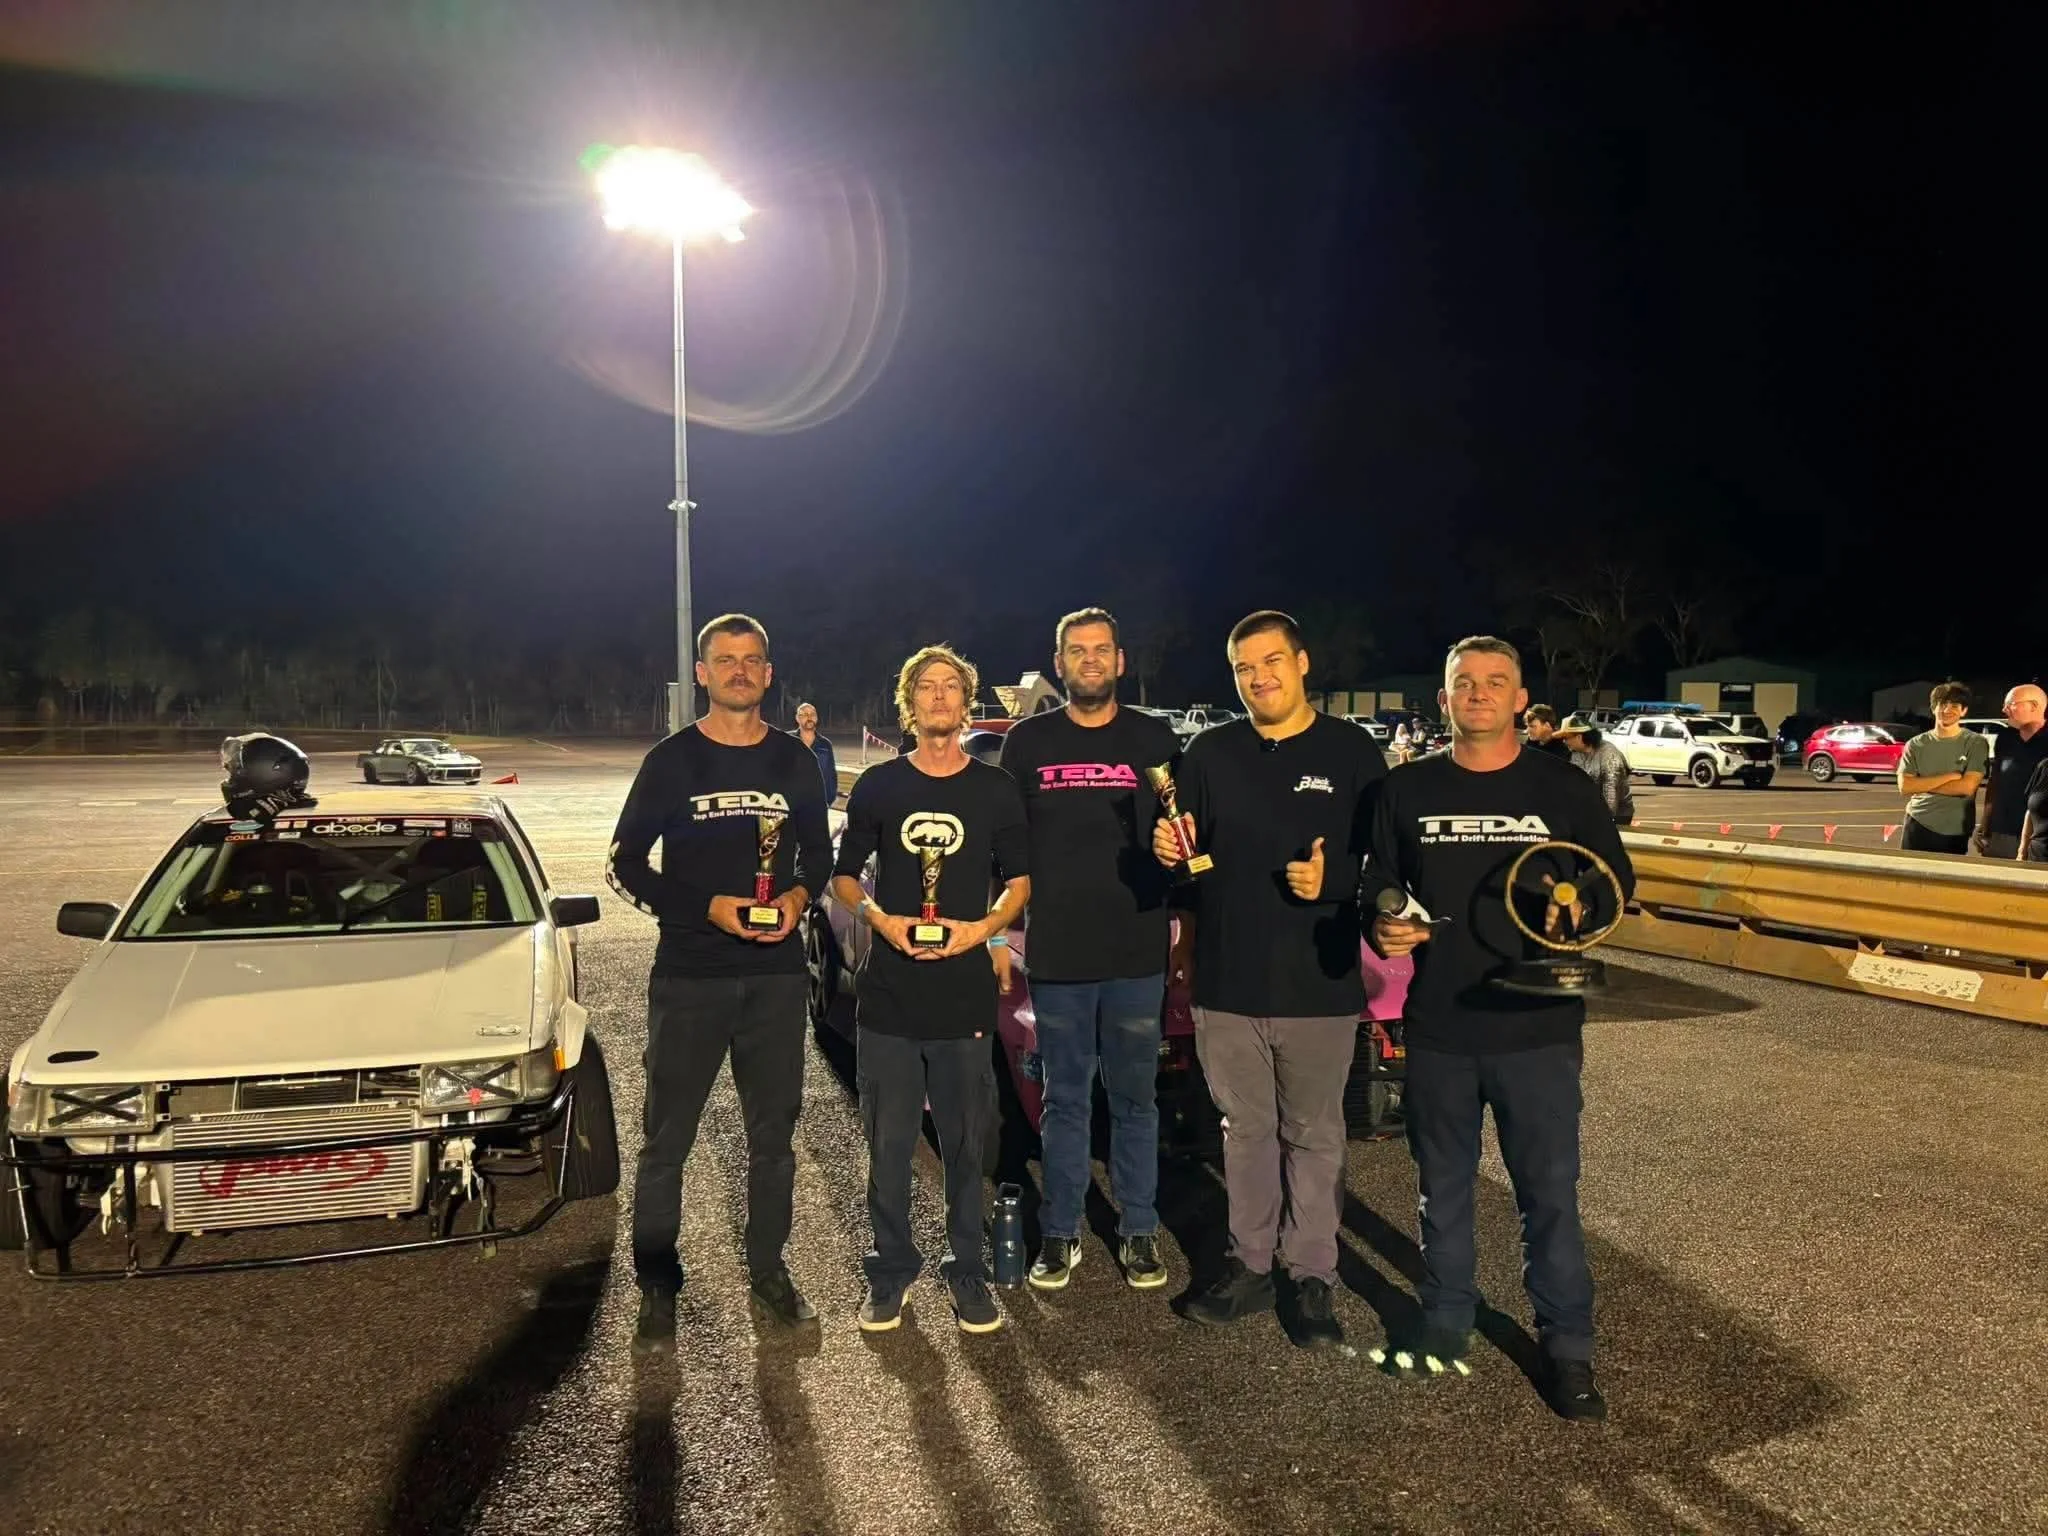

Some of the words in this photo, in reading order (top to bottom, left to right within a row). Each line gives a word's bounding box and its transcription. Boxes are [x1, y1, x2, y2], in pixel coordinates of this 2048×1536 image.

[1037, 763, 1138, 782] TEDA
[689, 791, 790, 812] TEDA
[692, 813, 707, 821] Top
[708, 809, 725, 819] End
[726, 808, 744, 817] Drift
[312, 821, 397, 834] abode
[1418, 815, 1551, 835] TEDA
[1420, 835, 1437, 844] Top
[1438, 834, 1459, 842] End
[1461, 834, 1486, 842] Drift
[1487, 834, 1550, 843] Association
